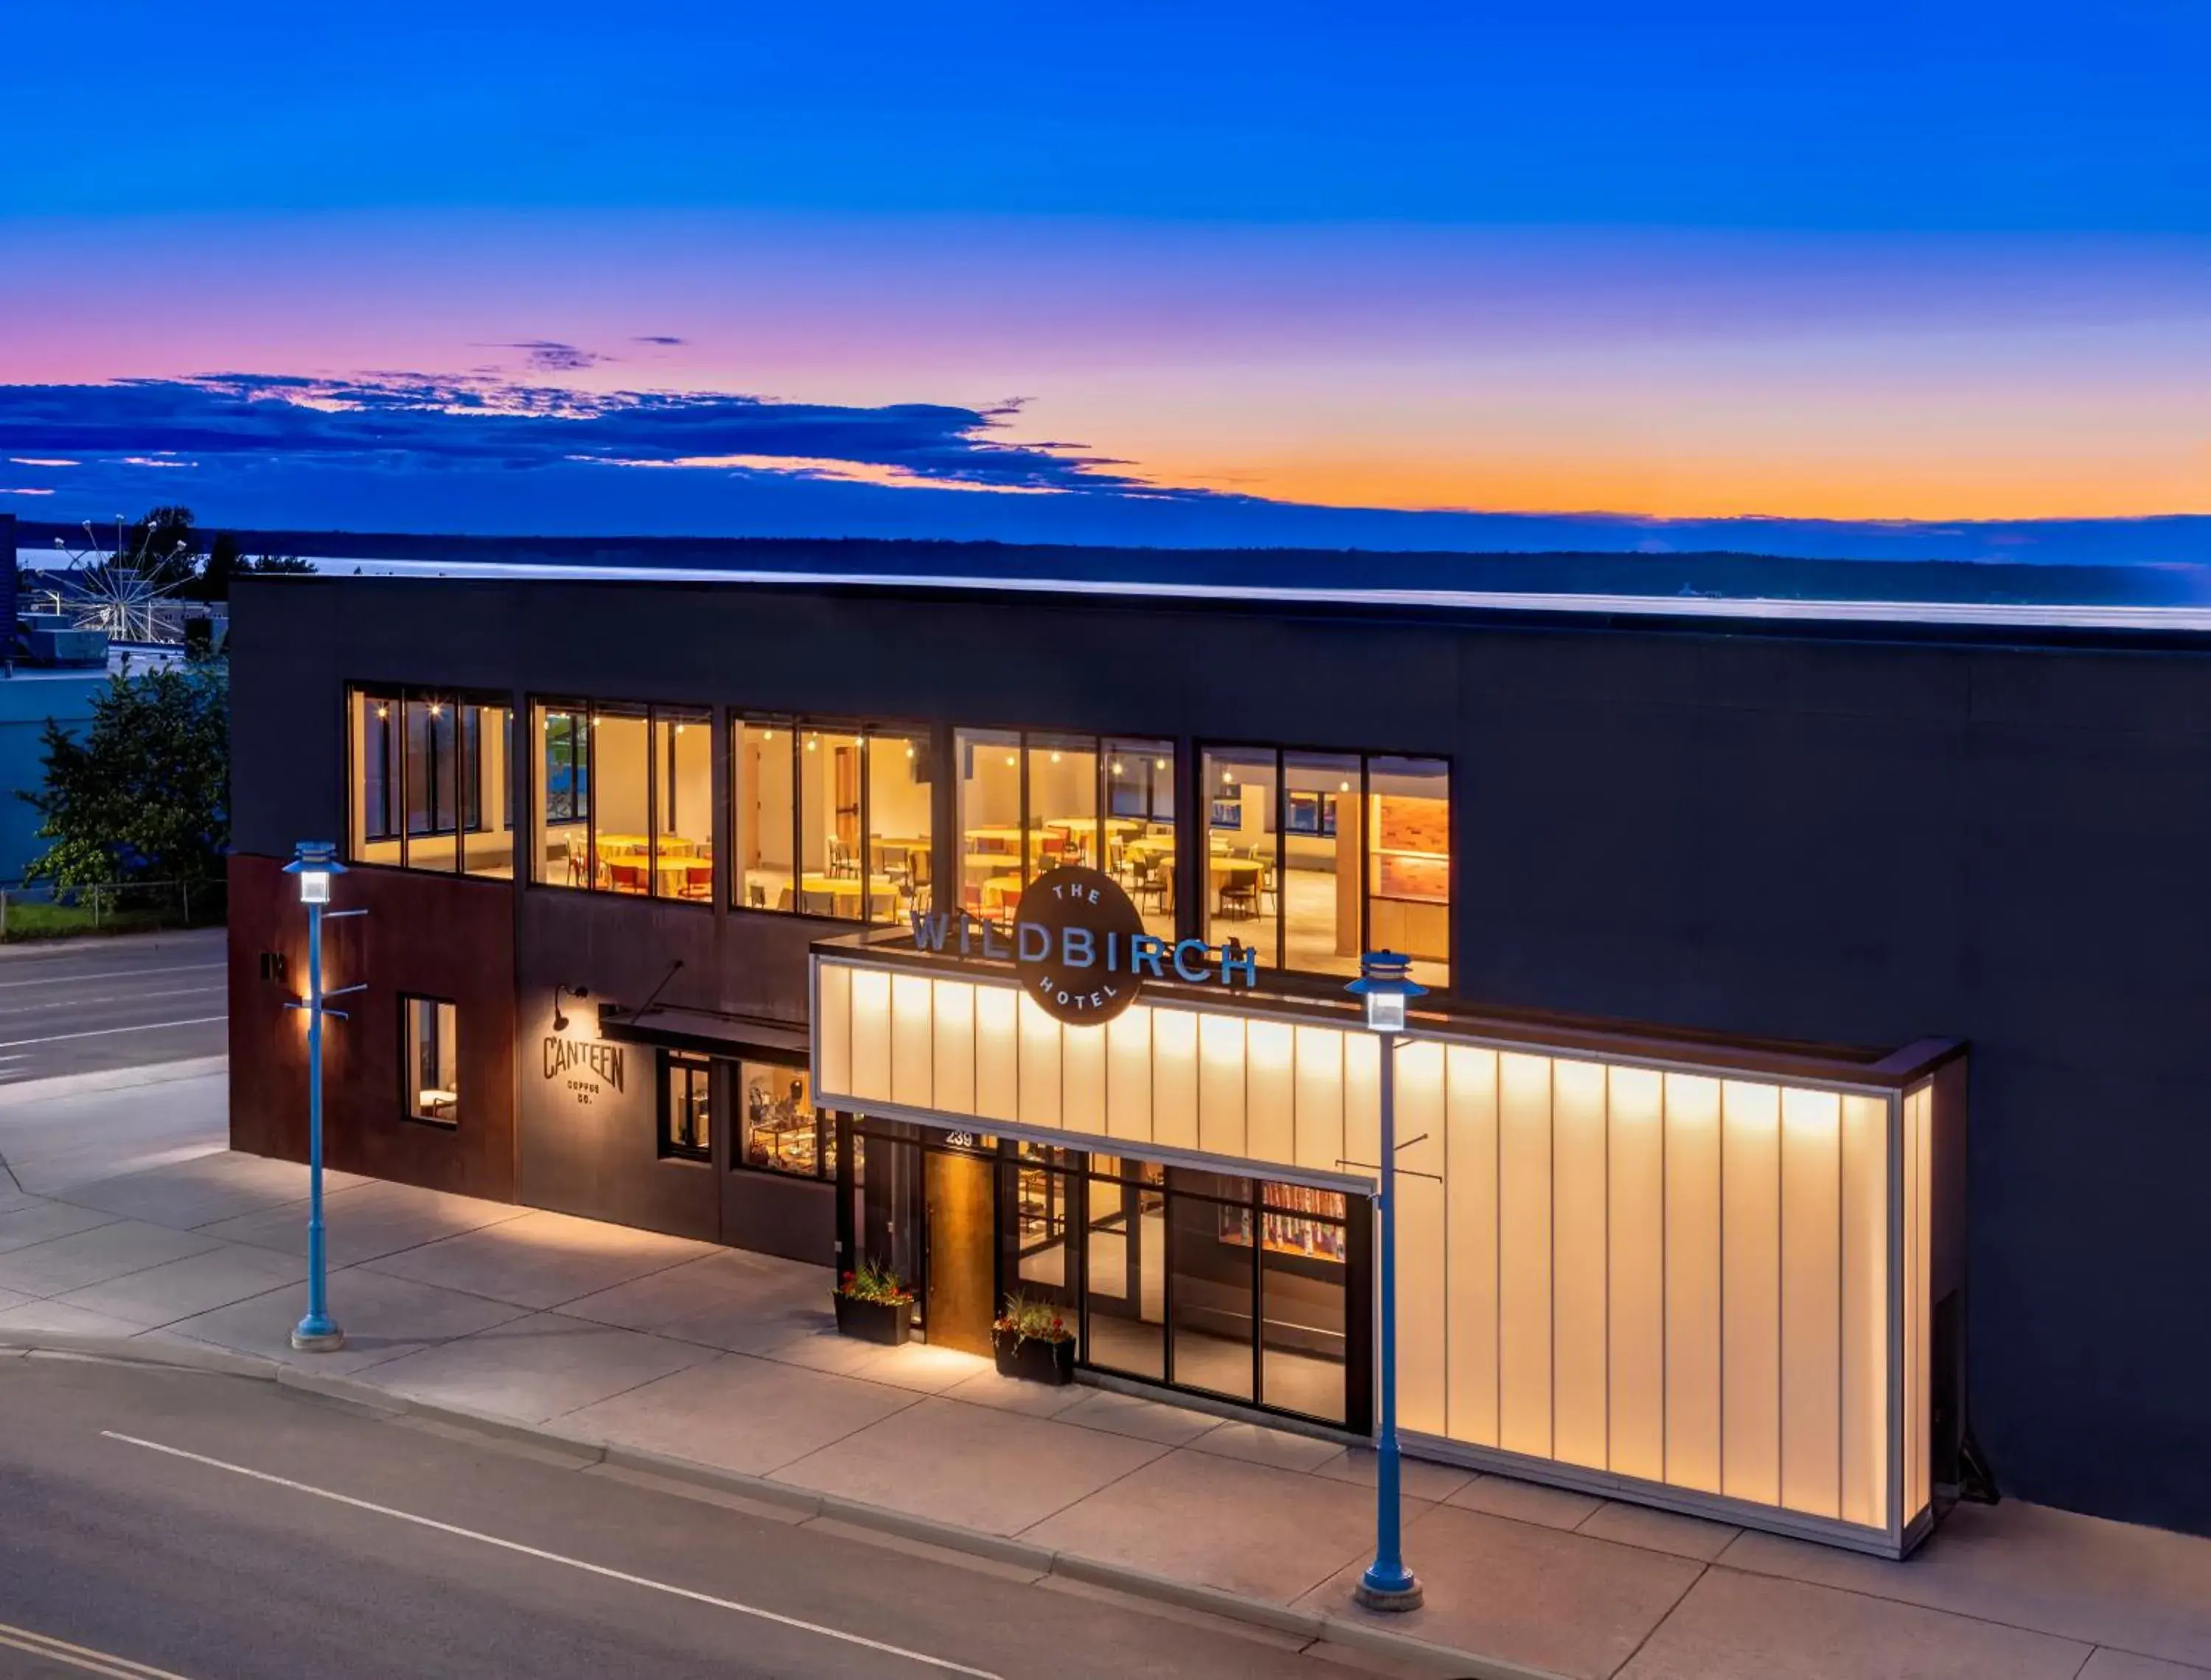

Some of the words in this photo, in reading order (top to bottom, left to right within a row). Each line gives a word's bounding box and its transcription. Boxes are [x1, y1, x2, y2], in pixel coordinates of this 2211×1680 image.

[1052, 883, 1100, 905] THE
[909, 910, 1257, 988] WILDBIRCH
[1039, 976, 1117, 1010] HOTEL
[544, 1037, 624, 1094] CANTEEN
[946, 1131, 972, 1147] 239
